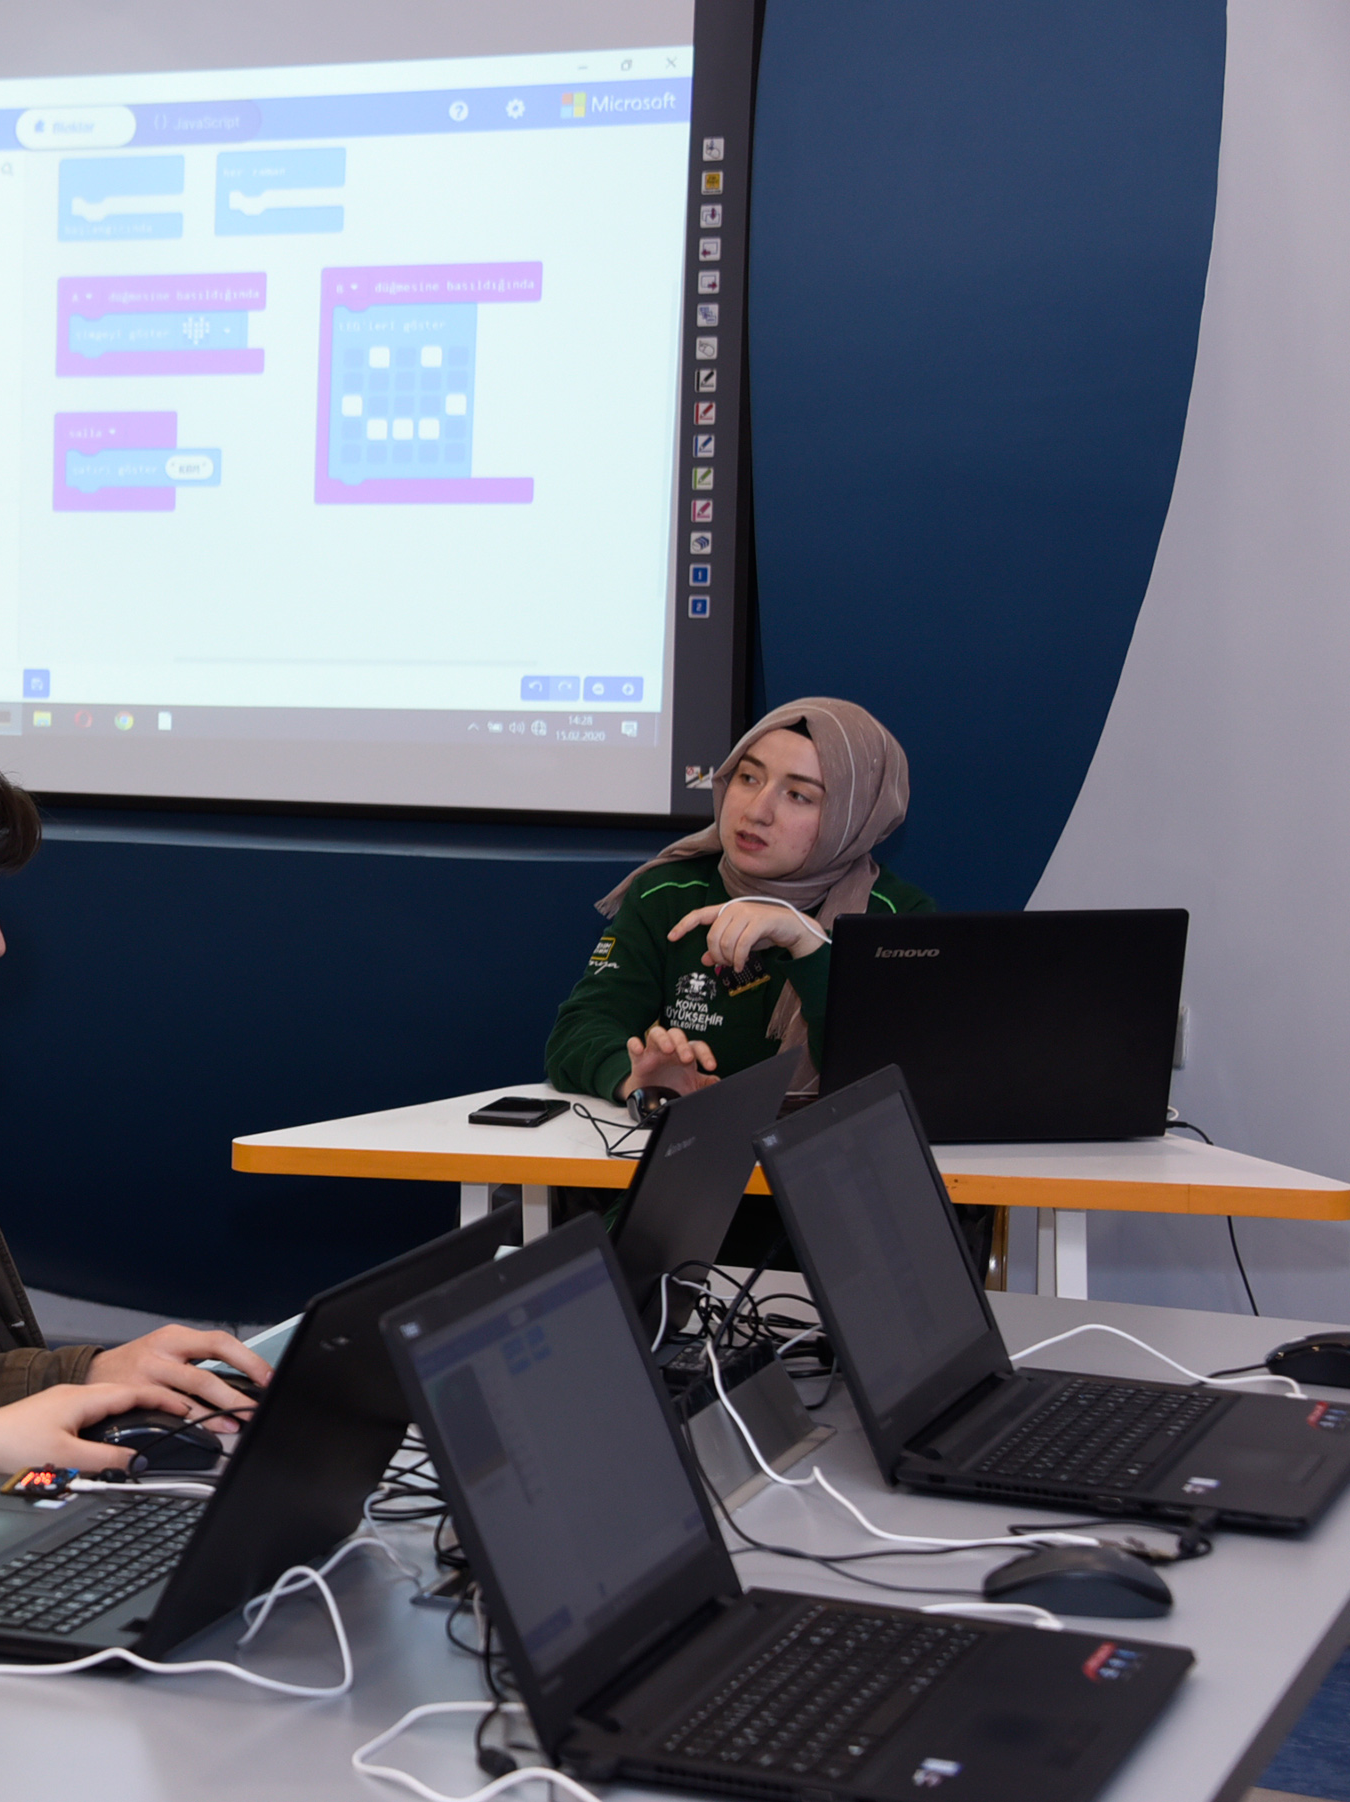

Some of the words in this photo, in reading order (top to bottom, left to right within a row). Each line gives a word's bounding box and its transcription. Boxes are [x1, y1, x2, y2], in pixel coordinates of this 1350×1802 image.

[590, 91, 677, 114] Microsoft
[172, 115, 241, 132] JavaScript
[874, 946, 940, 958] lenovo
[676, 999, 708, 1013] KONYA
[665, 1005, 723, 1026] ÜYÜKŞEHİR
